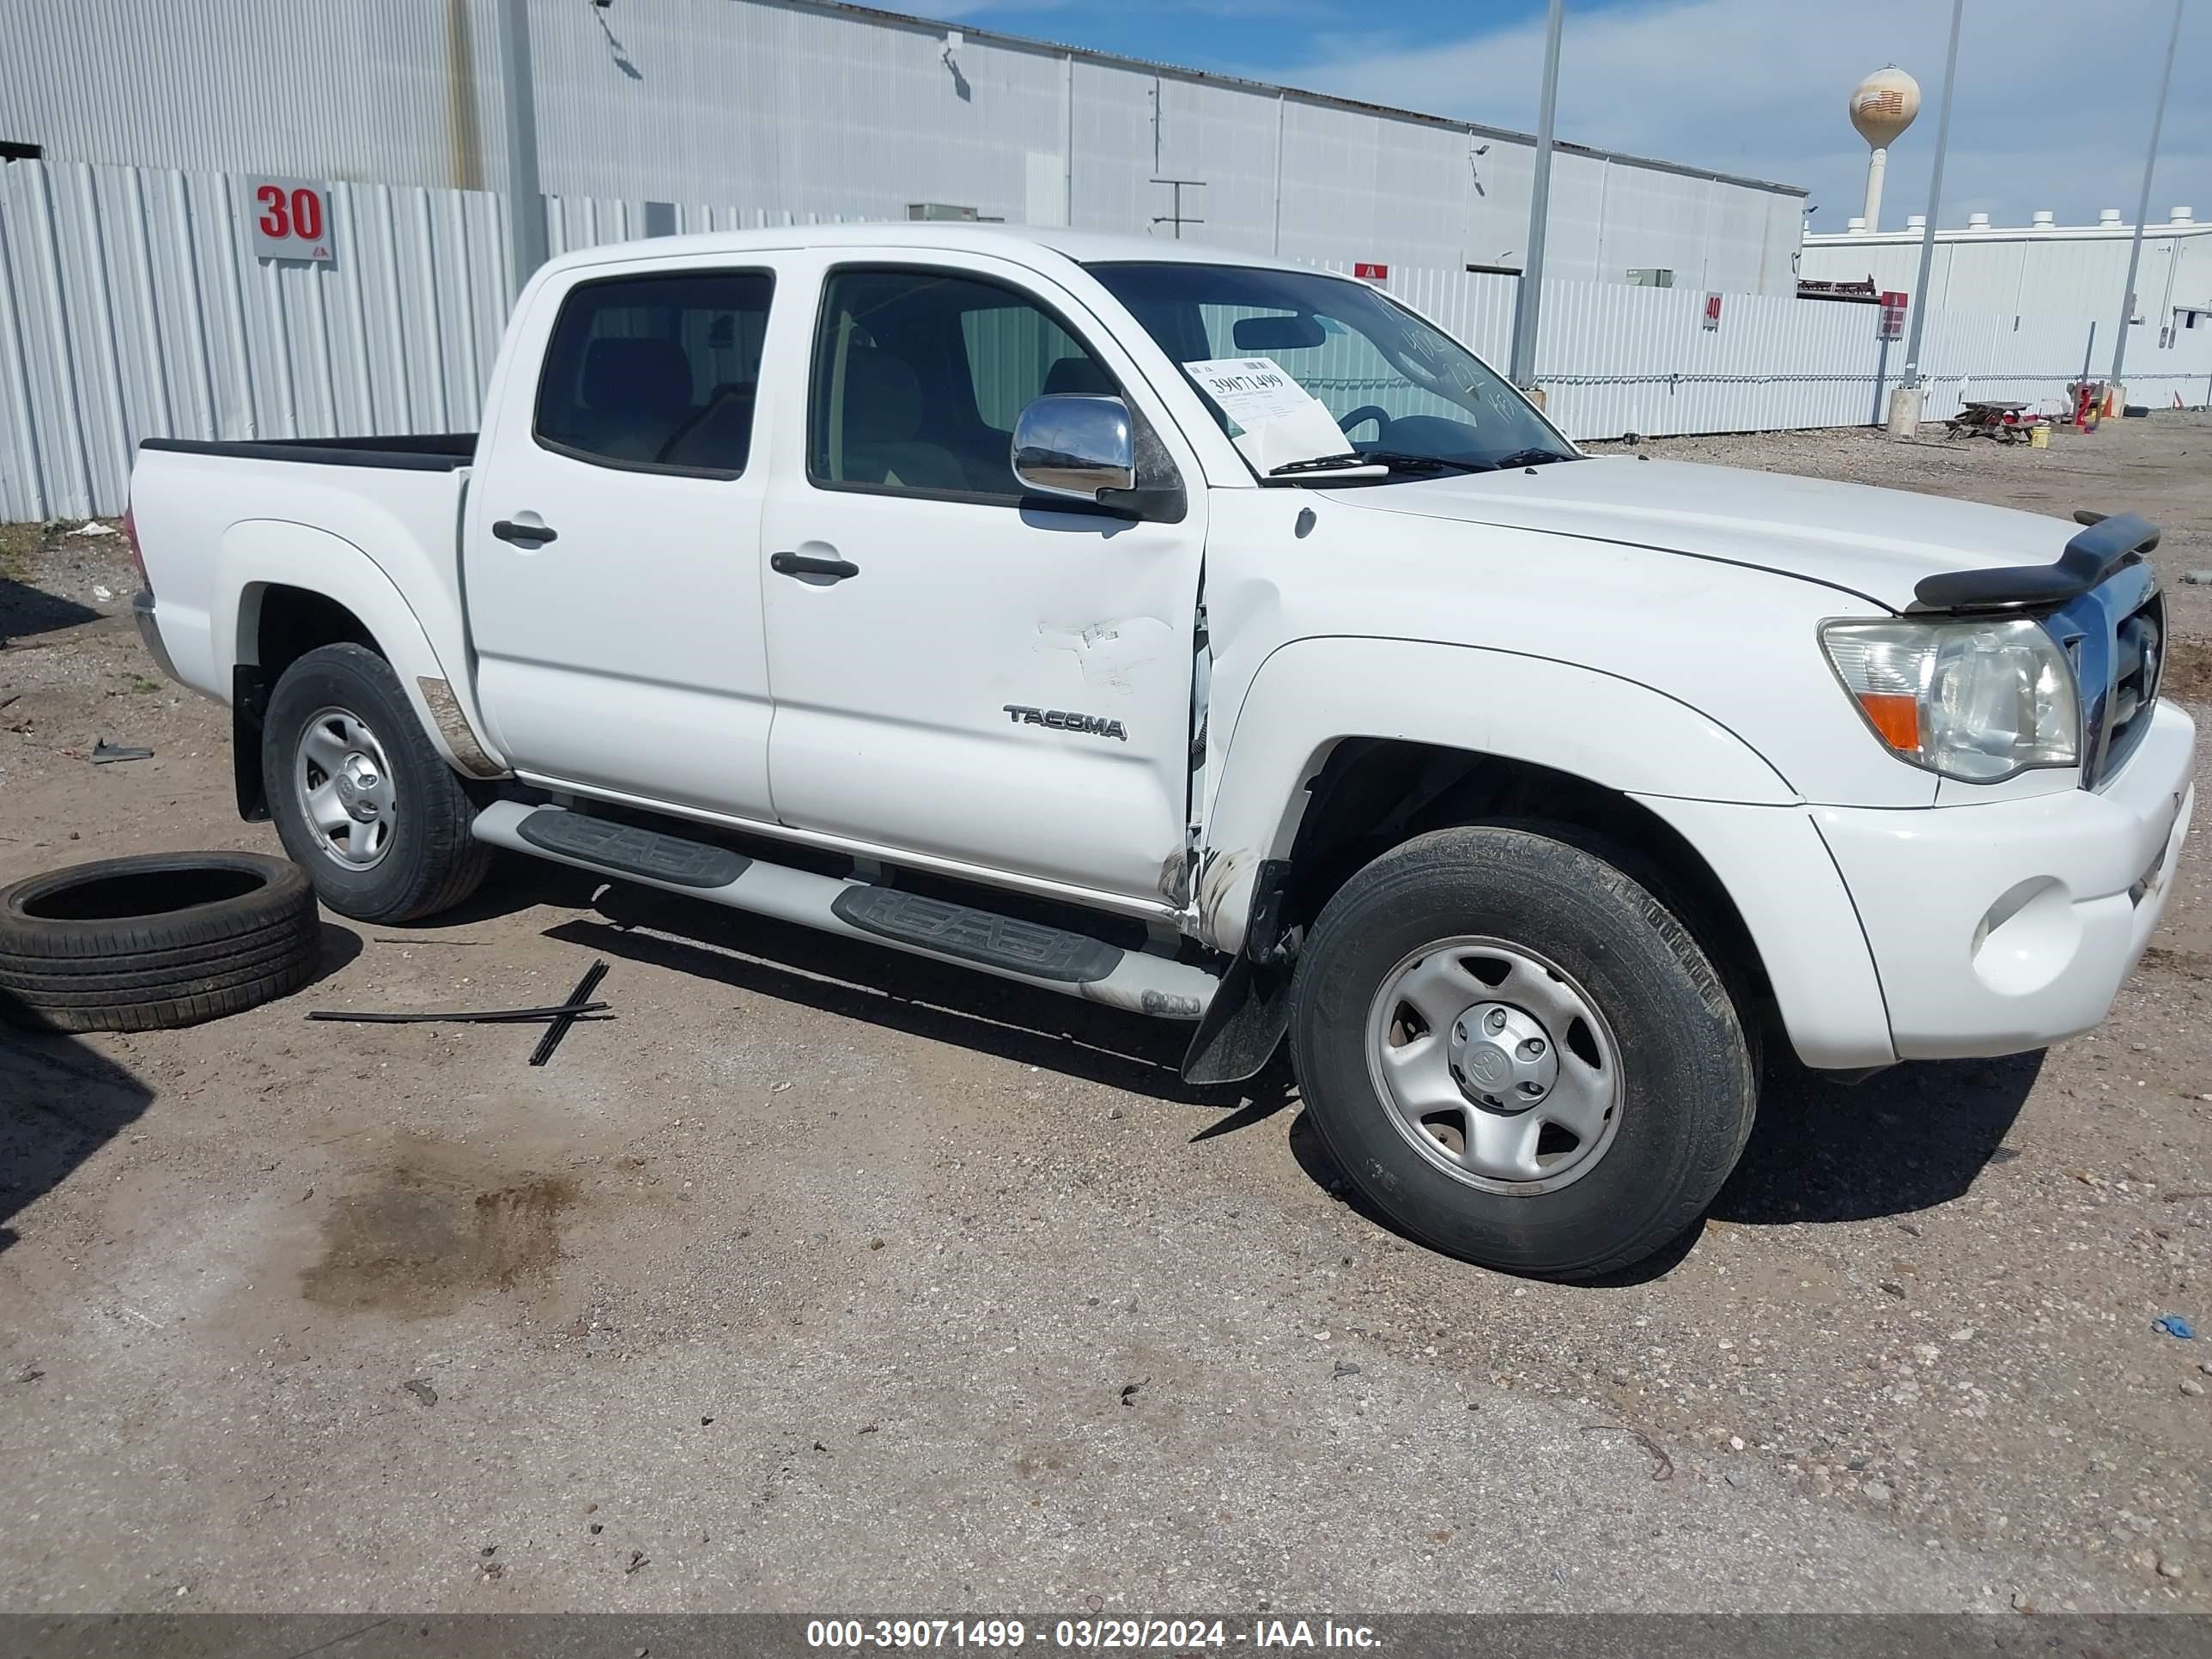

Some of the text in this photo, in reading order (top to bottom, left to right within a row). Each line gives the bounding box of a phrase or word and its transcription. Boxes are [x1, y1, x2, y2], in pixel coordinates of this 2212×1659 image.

[258, 185, 323, 240] 30
[1706, 296, 1721, 319] 40
[1209, 374, 1284, 393] 39071499
[1002, 704, 1127, 742] TACOMA
